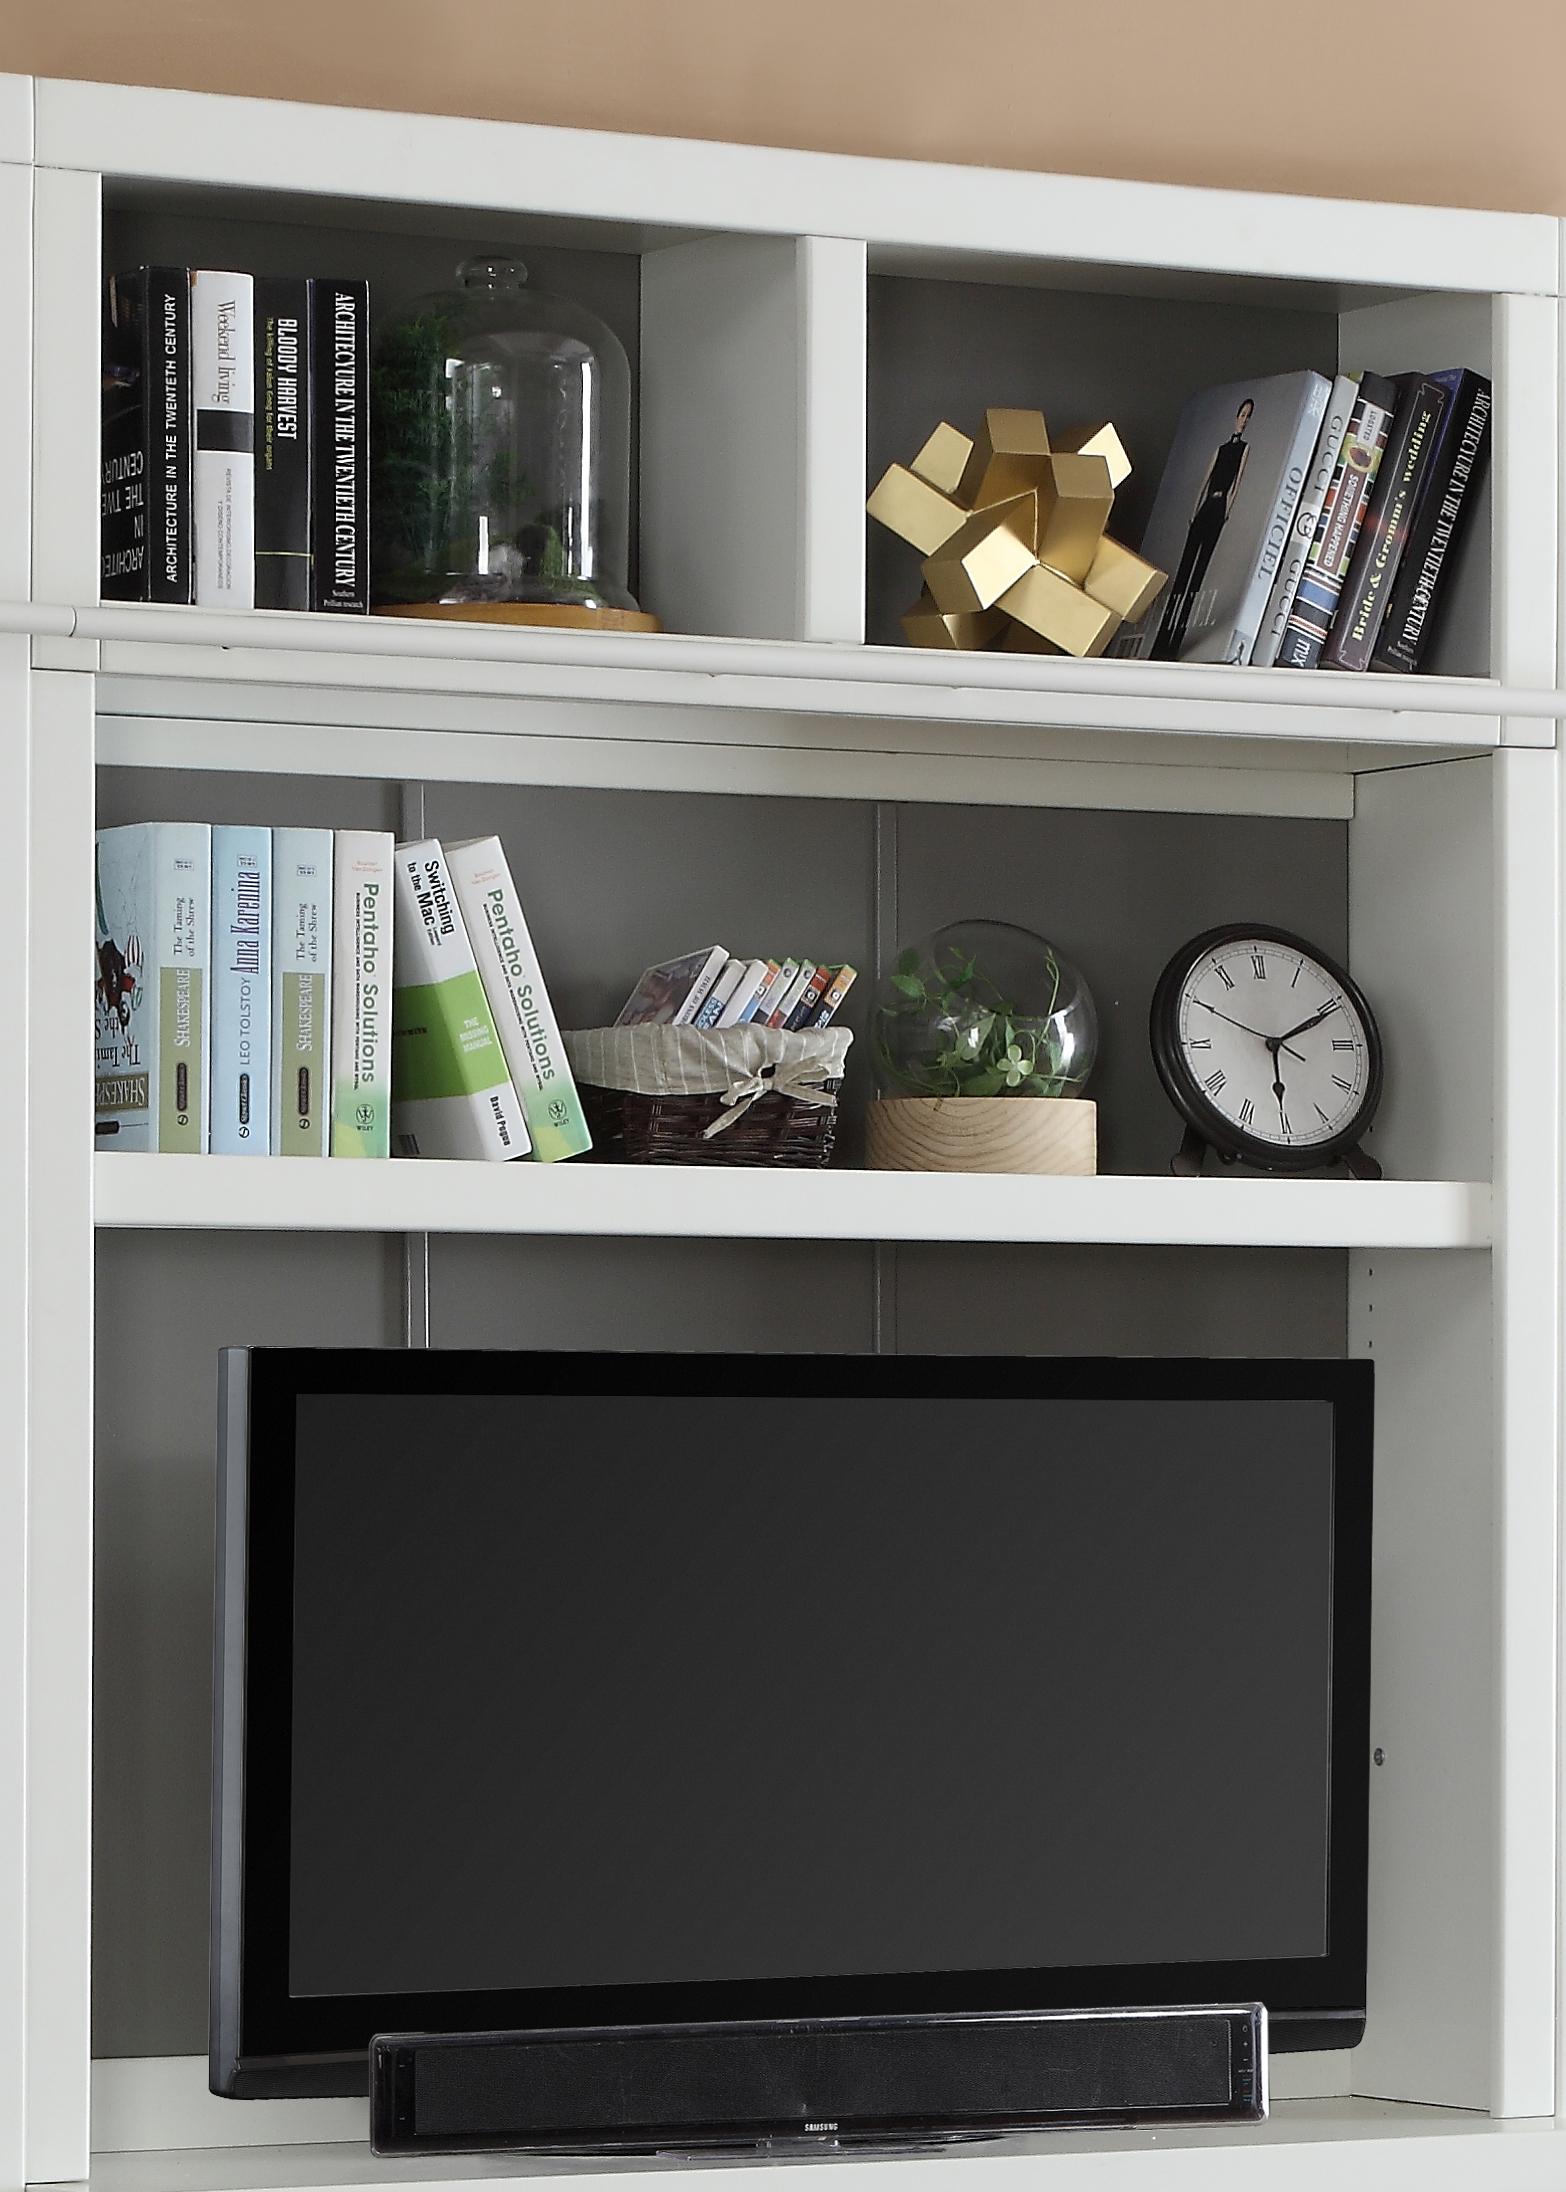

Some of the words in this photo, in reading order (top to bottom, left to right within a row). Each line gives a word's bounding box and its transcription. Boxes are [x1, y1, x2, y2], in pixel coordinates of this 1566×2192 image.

[164, 294, 177, 354] CENTURY
[218, 300, 236, 361] Weekend
[278, 318, 298, 374] BLOODY
[335, 292, 356, 396] ARCHITECYURE
[165, 360, 177, 428] TWENTETH
[211, 366, 236, 404] living
[278, 377, 298, 440] HARVEST
[335, 398, 356, 413] IN
[336, 415, 356, 442] THE
[1452, 389, 1490, 480] ARCHITECYURE
[166, 434, 177, 459] THE
[1314, 416, 1344, 492] GUCCI
[166, 466, 177, 478] IN
[336, 444, 356, 522] TWENTIETH
[125, 483, 144, 510] THE
[1337, 474, 1358, 523] SOMETHING
[1449, 479, 1465, 496] IN
[1440, 494, 1461, 520] THE
[134, 514, 144, 539] IN
[166, 484, 178, 583] ARCHITECTURE
[1258, 467, 1303, 579] OFFICIEL
[1352, 591, 1375, 640] Bride
[1369, 573, 1381, 588] &
[1403, 411, 1430, 481] wedding
[336, 524, 356, 588] CENTURY
[1323, 522, 1343, 567] HAPPENED
[1419, 520, 1452, 588] TWENTIETH
[1272, 560, 1300, 636] GUCCI
[1402, 587, 1431, 644] CENTURY
[1291, 638, 1311, 668] mix
[407, 862, 416, 873] to
[411, 874, 421, 891] the
[424, 860, 454, 934] Switching
[174, 898, 186, 933] Taming
[186, 898, 196, 926] Shrew
[230, 872, 259, 934] Karenina
[416, 891, 435, 925] Mac
[296, 904, 308, 938] Taming
[308, 904, 318, 932] Shrew
[362, 883, 379, 973] Pentaho
[174, 936, 184, 954] The
[186, 928, 196, 944] the
[308, 934, 318, 950] the
[185, 946, 195, 957] of
[230, 941, 259, 974] Anna
[296, 942, 307, 960] The
[308, 952, 318, 962] of
[1214, 966, 1234, 991] XI
[1251, 955, 1266, 979] XII
[1291, 966, 1300, 988] I
[487, 889, 522, 976] Pentaho
[517, 985, 554, 1079] Solutions
[174, 970, 190, 1047] SHAKESPEARE
[240, 978, 250, 1036] TOLSTOY
[296, 974, 312, 1051] SHAKESPEARE
[362, 984, 378, 1082] Solutions
[1188, 1038, 1212, 1049] IX
[1332, 1040, 1354, 1050] III
[122, 1044, 141, 1066] The
[240, 1041, 250, 1066] LEO
[1204, 1070, 1227, 1096] VIII
[1332, 1074, 1352, 1094] IV
[490, 1096, 504, 1120] David
[1239, 1098, 1254, 1125] VII
[1314, 1102, 1330, 1124] V
[1279, 1112, 1292, 1134] VI
[804, 2123, 838, 2131] SAMSUNG
